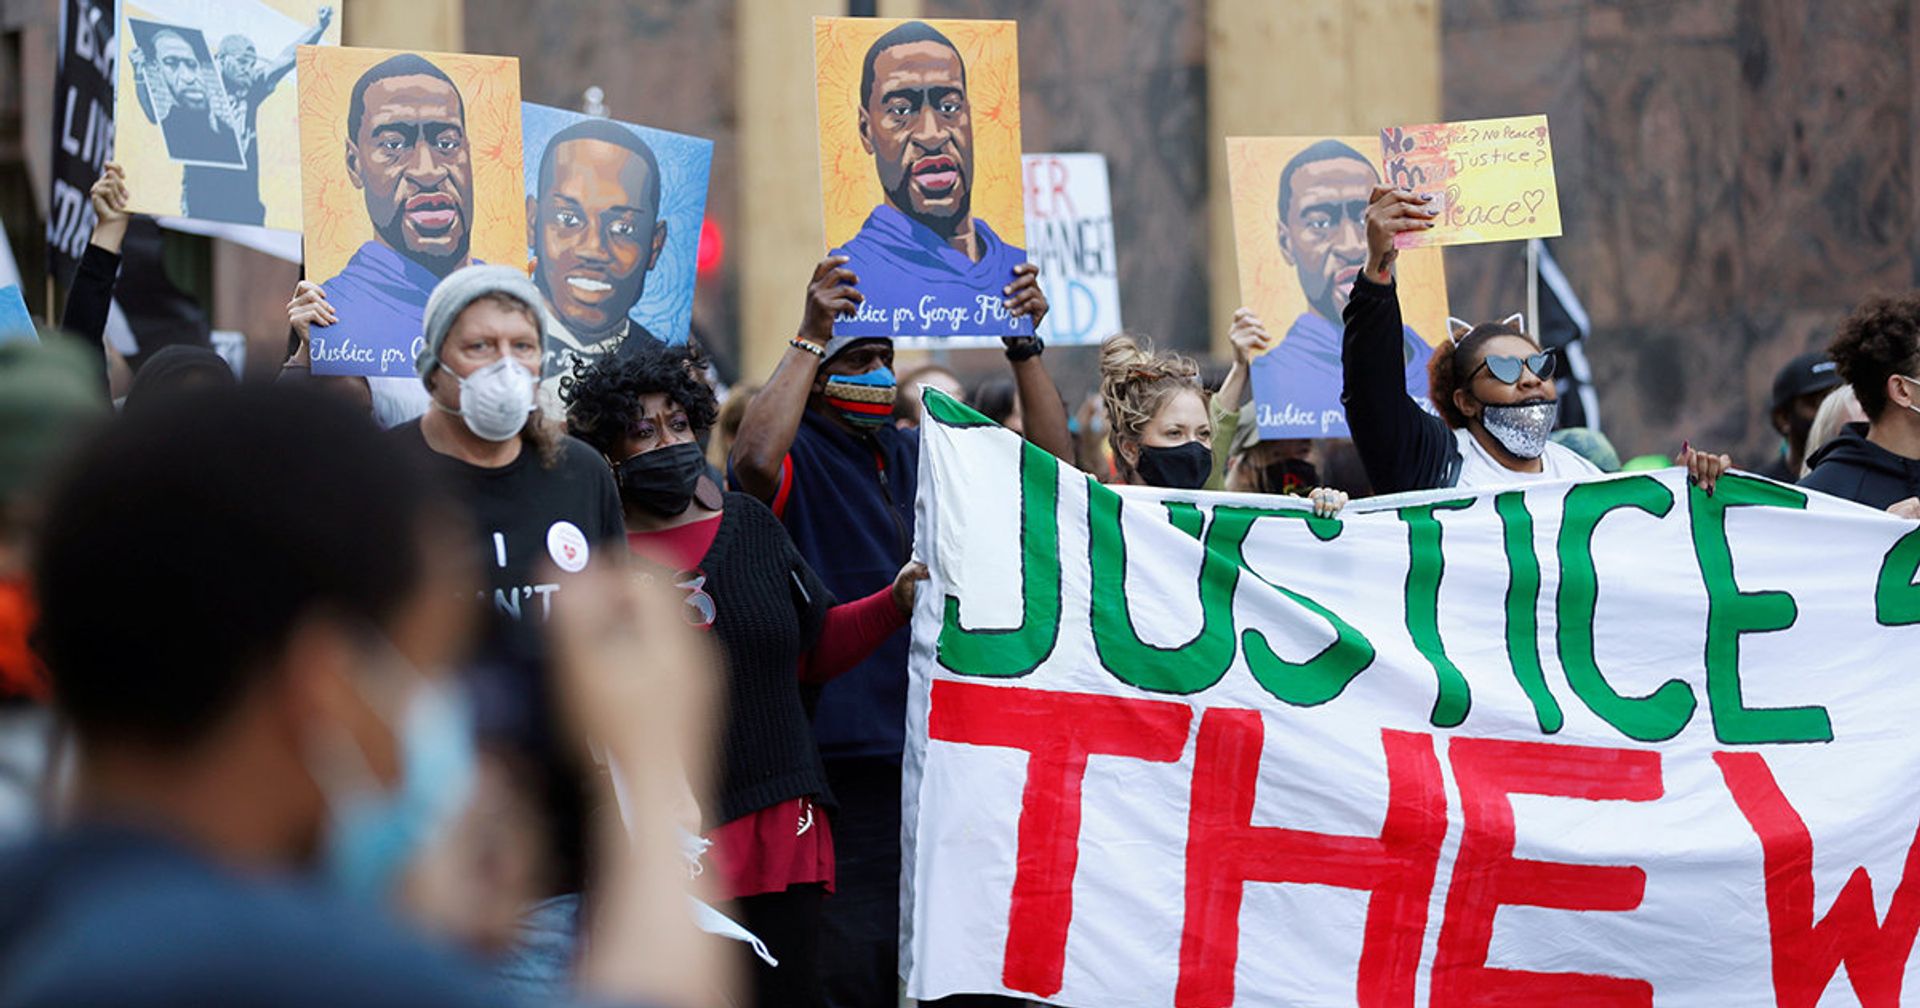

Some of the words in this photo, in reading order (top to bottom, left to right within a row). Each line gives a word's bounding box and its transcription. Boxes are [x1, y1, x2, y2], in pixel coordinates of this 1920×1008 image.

[1452, 148, 1547, 173] Justice?
[893, 307, 915, 331] for
[918, 295, 969, 331] George
[310, 338, 376, 362] Justice
[381, 347, 406, 372] for
[1256, 403, 1317, 427] Justice
[922, 386, 1834, 745] JUSTICE
[929, 680, 1664, 1008] THE
